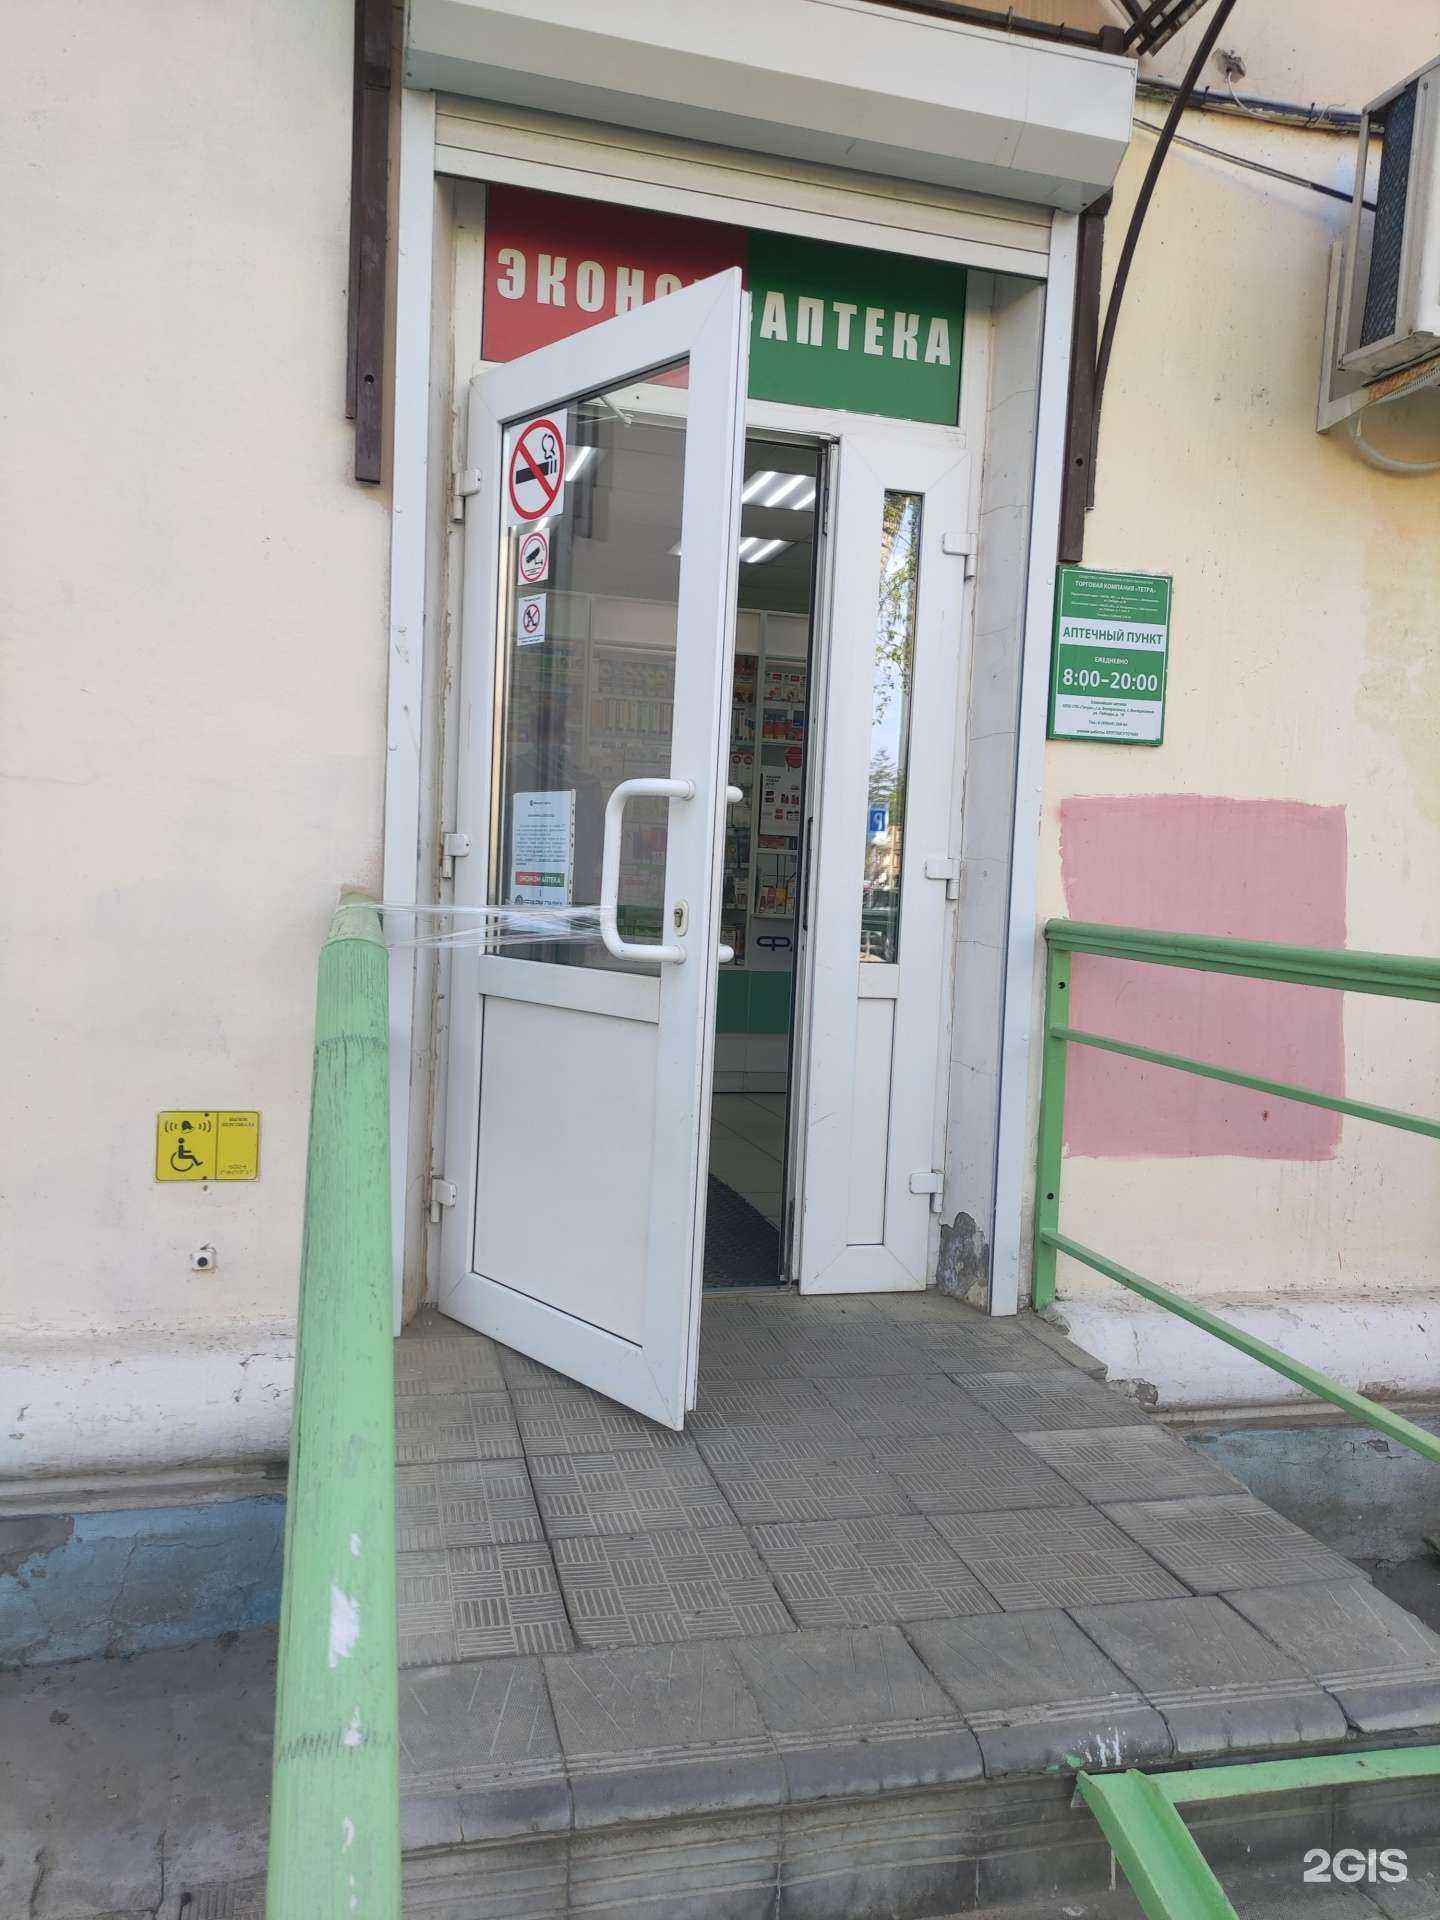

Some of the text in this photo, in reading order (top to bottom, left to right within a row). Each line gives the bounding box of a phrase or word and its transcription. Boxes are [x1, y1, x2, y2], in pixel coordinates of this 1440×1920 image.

[497, 248, 952, 366] ЭКОН АПТЕКА
[1063, 626, 1164, 644] АПТЕЧНЫЙ ПУНКТ
[1094, 656, 1129, 665] ЕЖЕДНЕВНО
